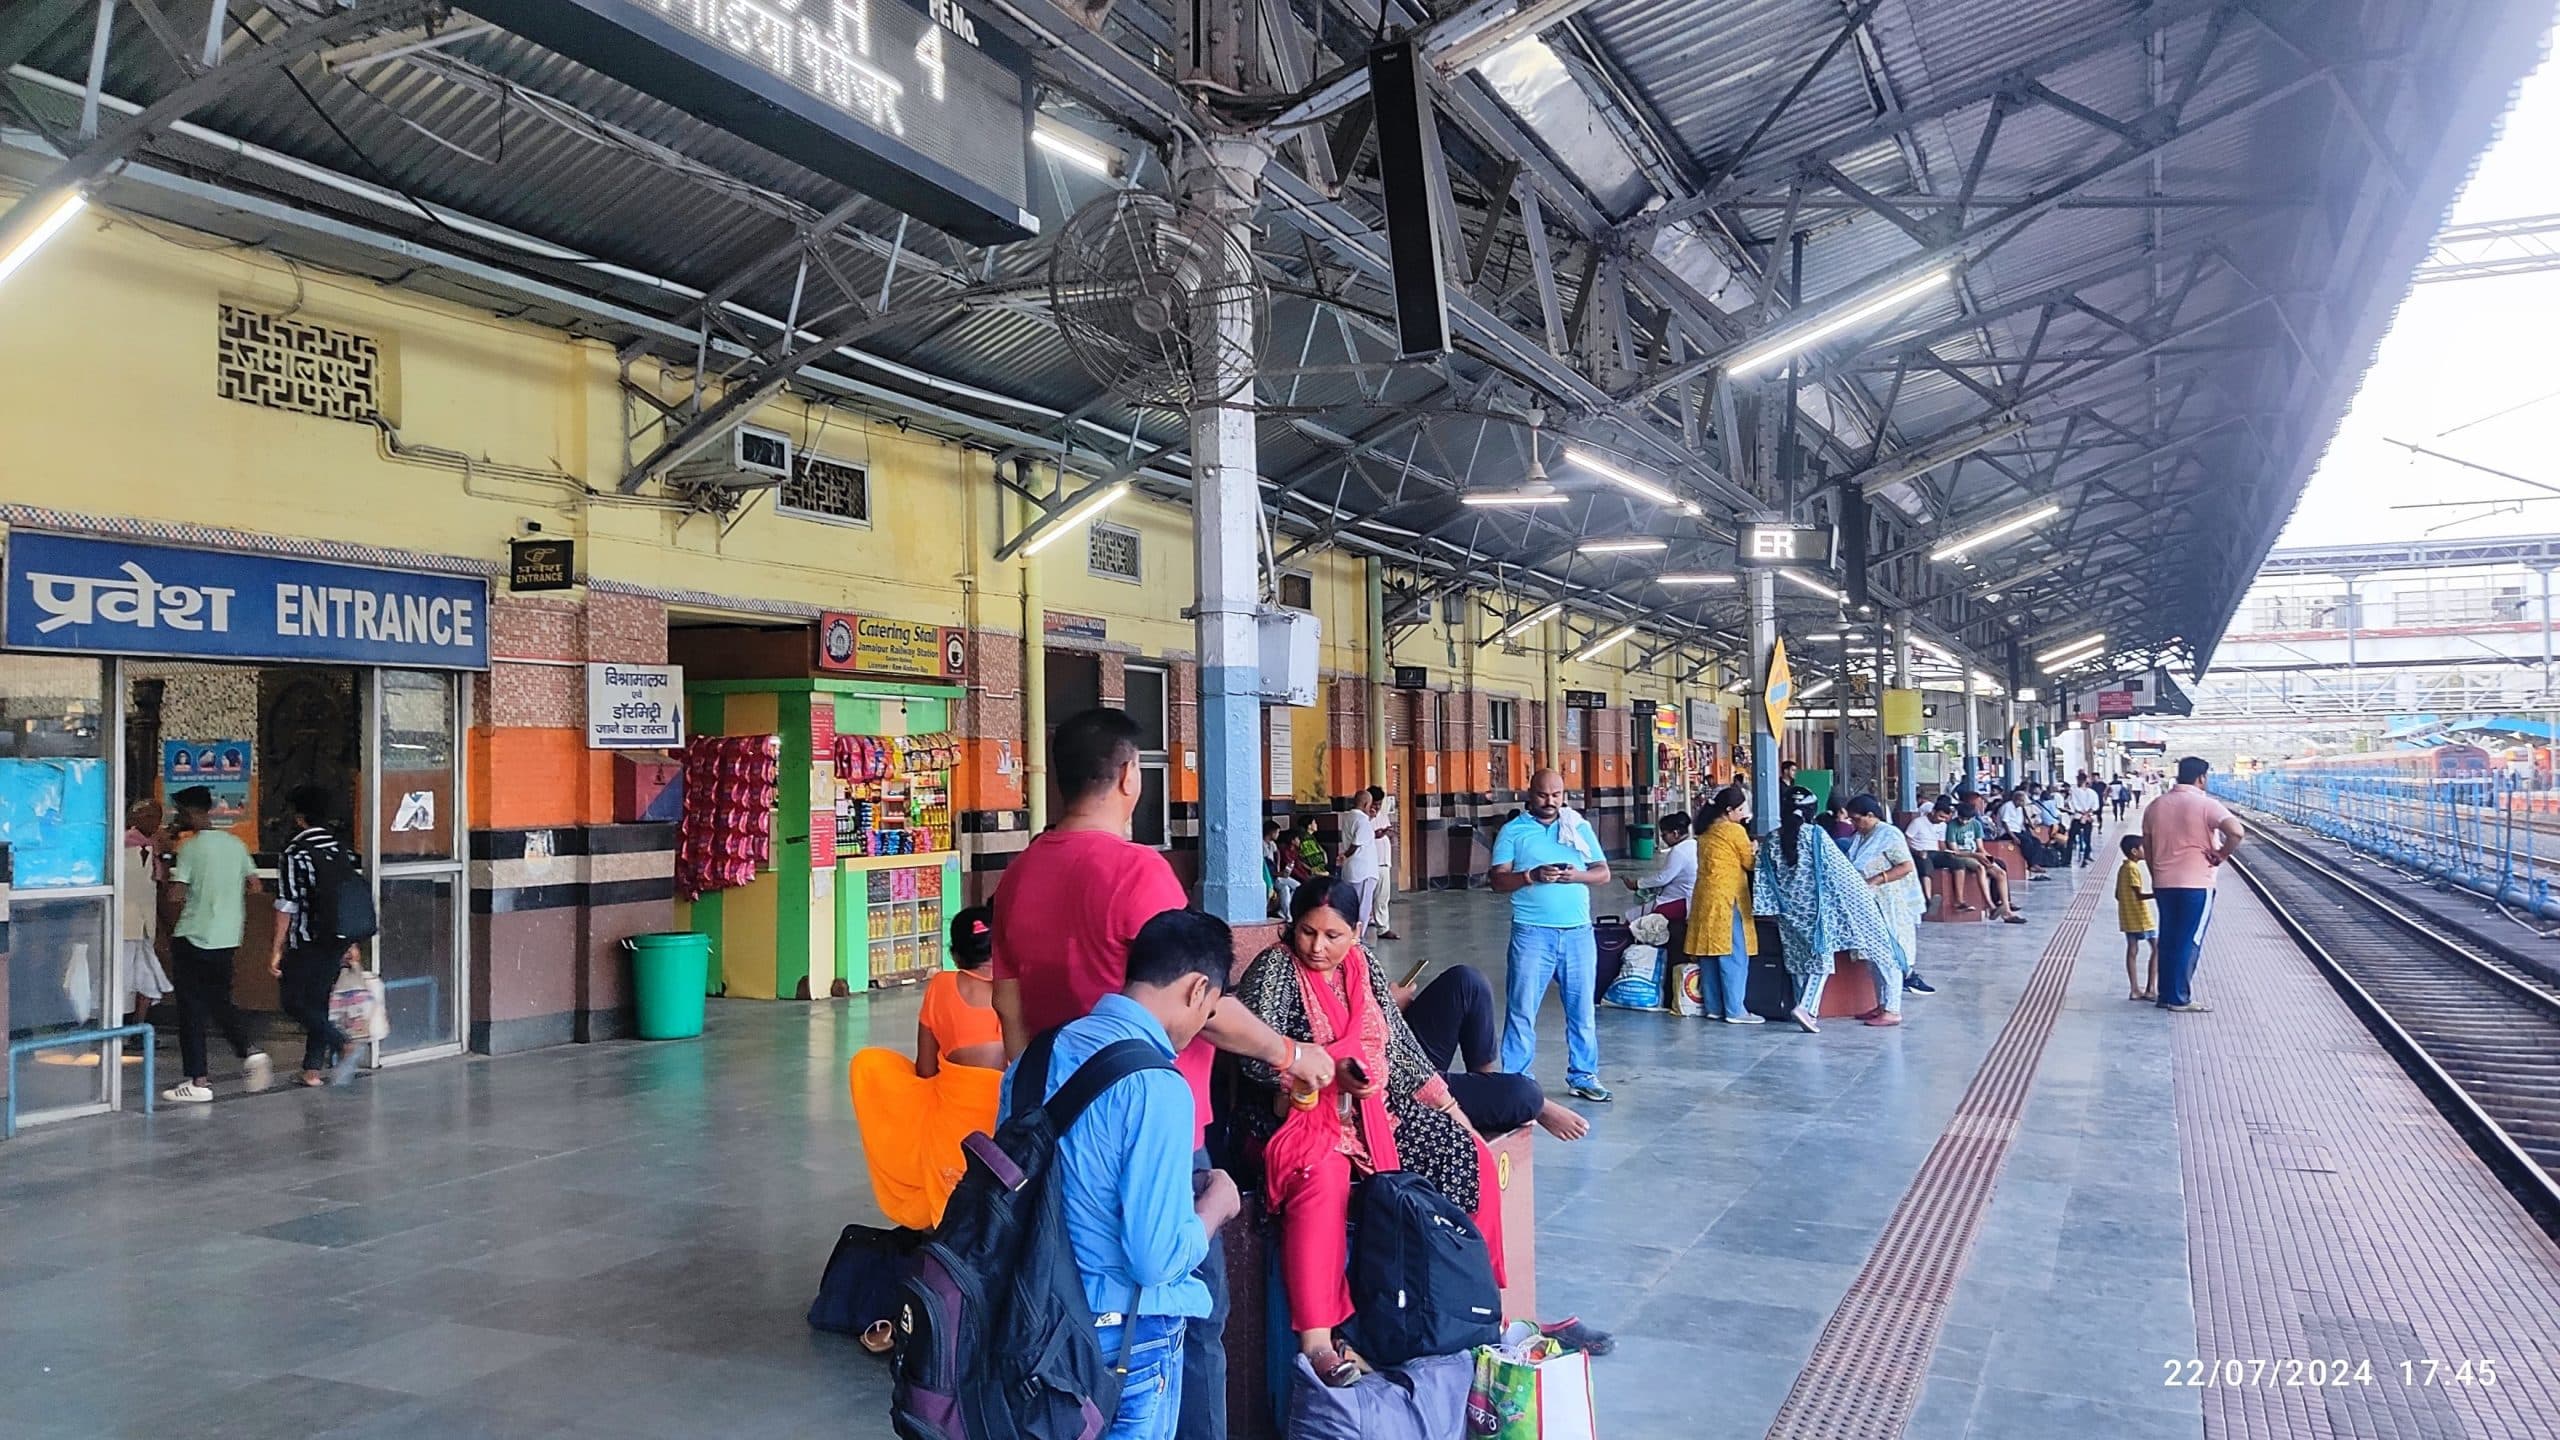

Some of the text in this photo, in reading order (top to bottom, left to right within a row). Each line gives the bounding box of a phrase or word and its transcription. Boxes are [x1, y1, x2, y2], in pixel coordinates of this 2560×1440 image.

[914, 23, 945, 101] 4
[1753, 530, 1796, 559] ER
[516, 572, 563, 584] ENTRANCE
[26, 560, 474, 647] प्रवेश ENTRANCE
[858, 619, 910, 646] Catering
[913, 626, 938, 643] Stall
[857, 641, 939, 659] Jamalpur Railway Station
[605, 667, 668, 688] विश्रामालय
[612, 702, 662, 724] डॉरमिट्री
[595, 721, 668, 735] जाने का रास्ता
